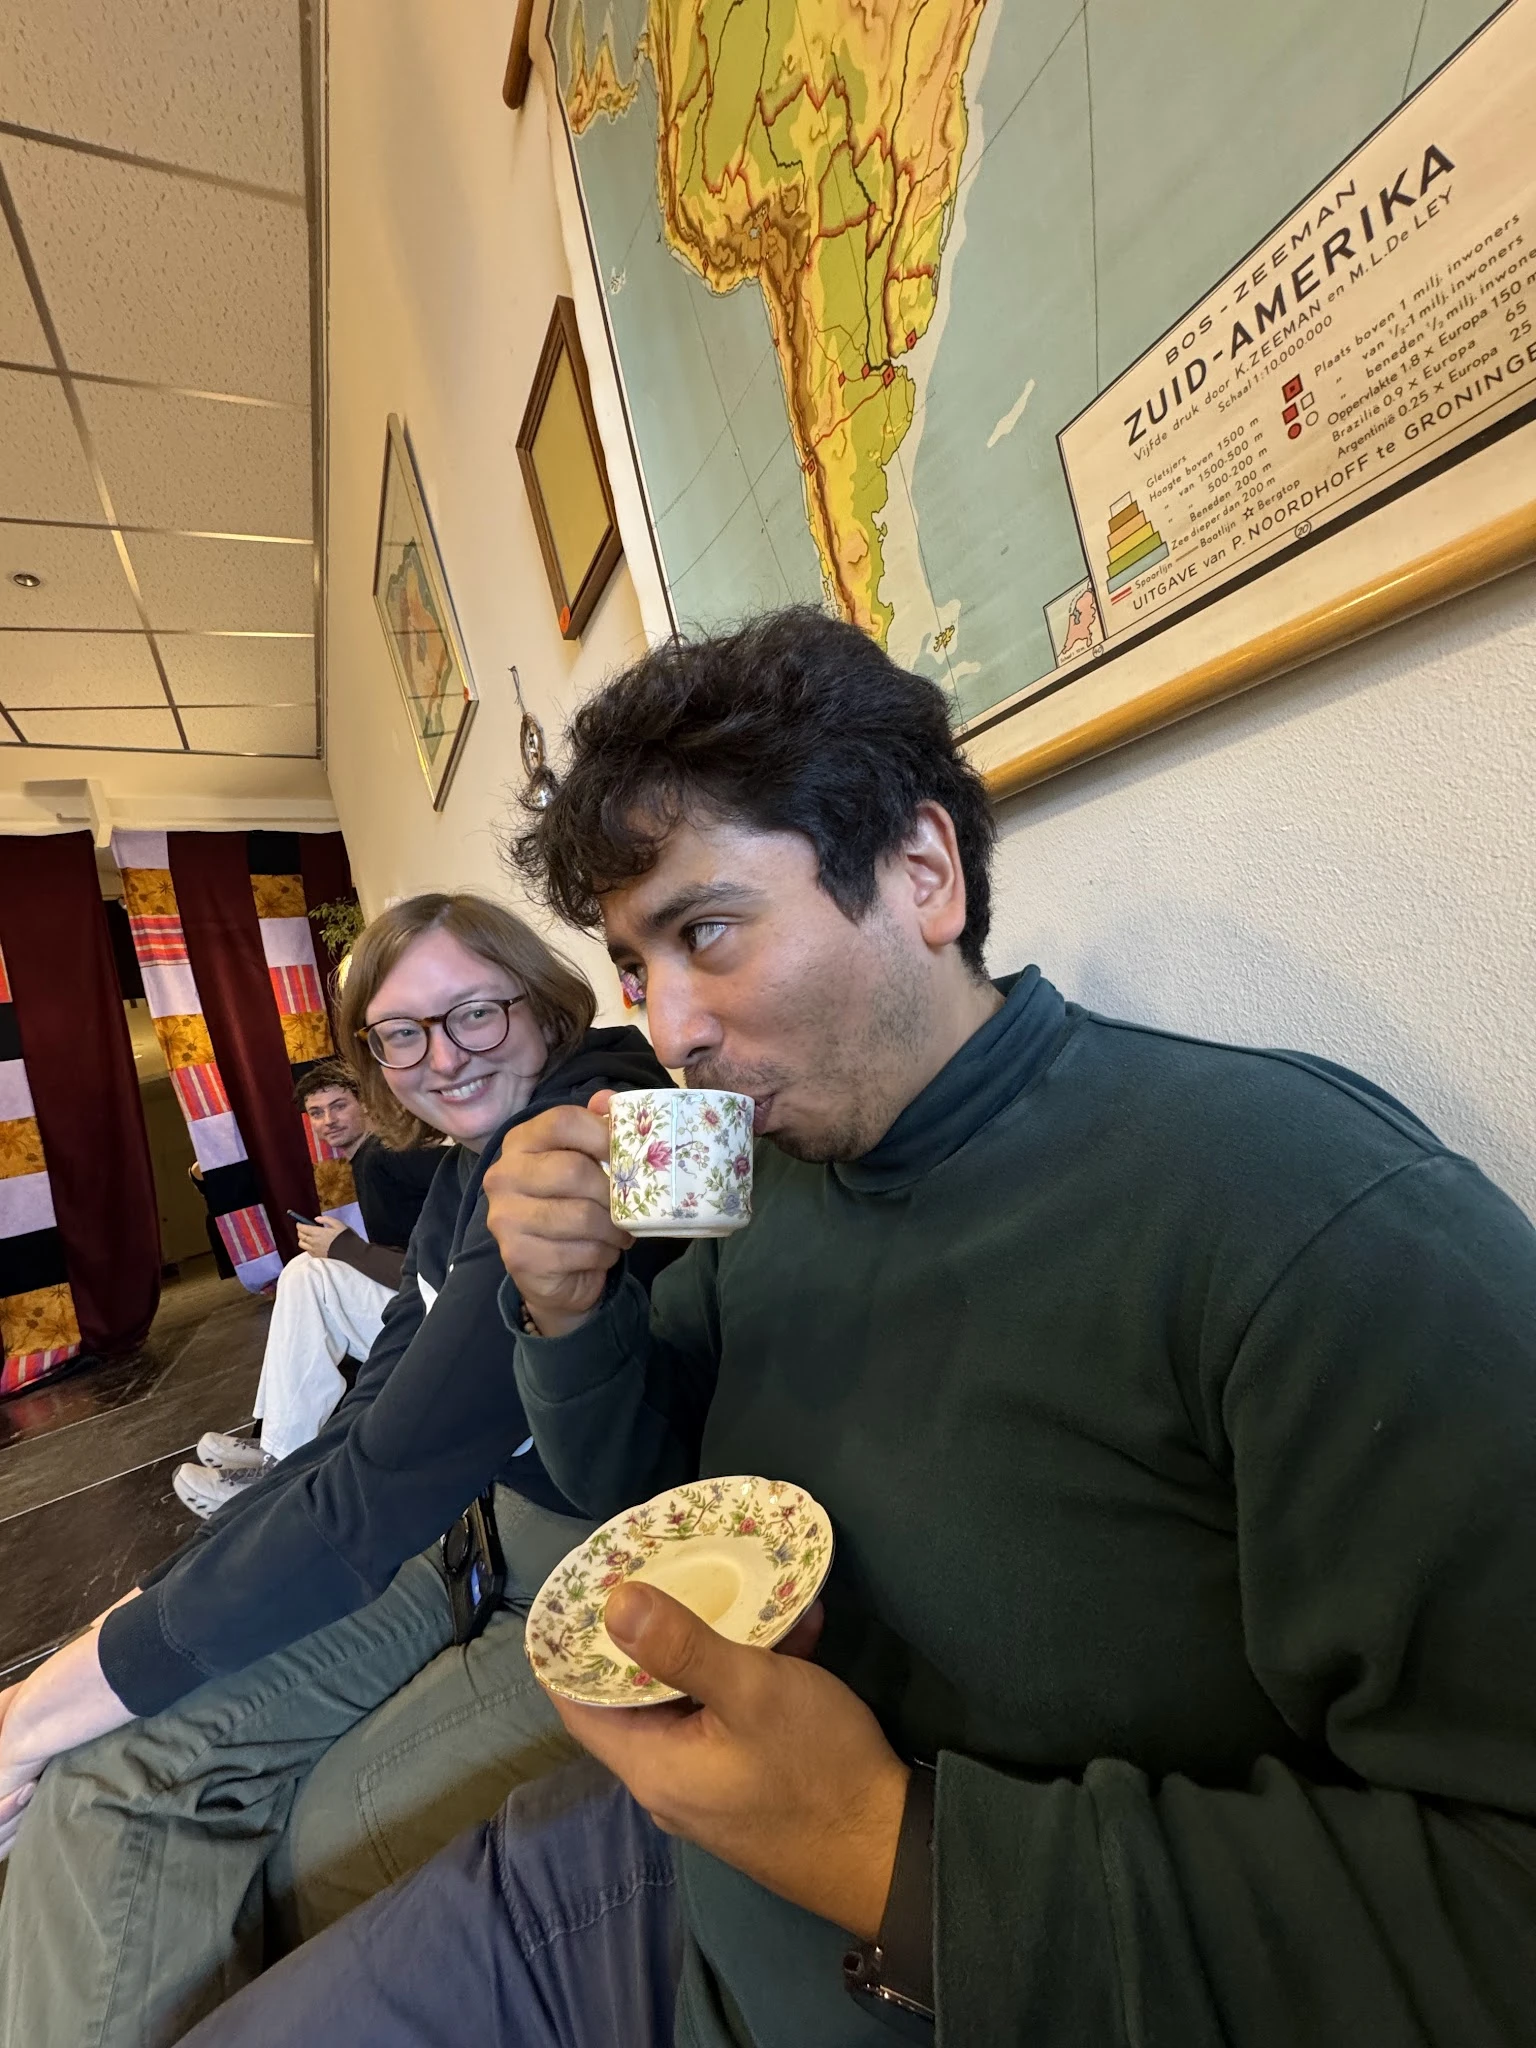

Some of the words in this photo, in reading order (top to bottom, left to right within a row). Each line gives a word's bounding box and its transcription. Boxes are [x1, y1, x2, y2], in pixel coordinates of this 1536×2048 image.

[1123, 144, 1455, 446] ZUID-AMERIKA
[1133, 431, 1168, 461] Vijfde
[1172, 404, 1200, 431] druk
[1204, 379, 1230, 405] door
[1327, 284, 1345, 303] en
[1413, 185, 1452, 230] LEY
[1314, 344, 1351, 377] Plaats
[1355, 311, 1395, 346] boven
[1399, 298, 1406, 311] 1
[1413, 273, 1443, 301] milj.
[1447, 213, 1520, 275] inwoners
[1361, 340, 1385, 360] van
[1419, 291, 1449, 319] milj.
[1450, 234, 1524, 294] inwoners
[1365, 332, 1424, 378] beneden
[1446, 293, 1478, 320] milj.
[1217, 379, 1252, 413] Schaal
[1327, 372, 1398, 425] Oppervlakte
[1438, 308, 1488, 347] Europa
[1491, 280, 1522, 308] 150
[1331, 405, 1381, 443] Brazilië
[1422, 339, 1476, 380] Europa
[1505, 299, 1527, 323] 65
[1337, 414, 1396, 459] Argentinië
[1448, 346, 1499, 384] Europa
[1509, 319, 1532, 343] 25
[1146, 455, 1187, 488] Gletsjers
[1149, 475, 1182, 502] Hoogte
[1185, 451, 1214, 476] boven
[1217, 425, 1245, 451] 1500
[1249, 417, 1260, 428] m
[1171, 535, 1189, 551] Zee
[1190, 513, 1221, 538] dieper
[1222, 500, 1241, 517] dan
[1241, 481, 1264, 504] 200
[1265, 476, 1276, 488] m
[1178, 482, 1195, 497] van
[1198, 440, 1249, 482] 1500-500
[1253, 431, 1264, 443] m
[1189, 490, 1231, 523] Beneden
[1234, 470, 1257, 492] 200
[1261, 461, 1272, 473] m
[1207, 455, 1253, 494] 500-200
[1257, 446, 1268, 458] m
[1132, 562, 1198, 610] UITGAVE
[1202, 549, 1227, 569] van
[1376, 441, 1396, 459] te
[1134, 562, 1173, 590] Spoorlijn
[1199, 520, 1237, 548] Bootlijn
[1257, 479, 1301, 511] Bergtop
